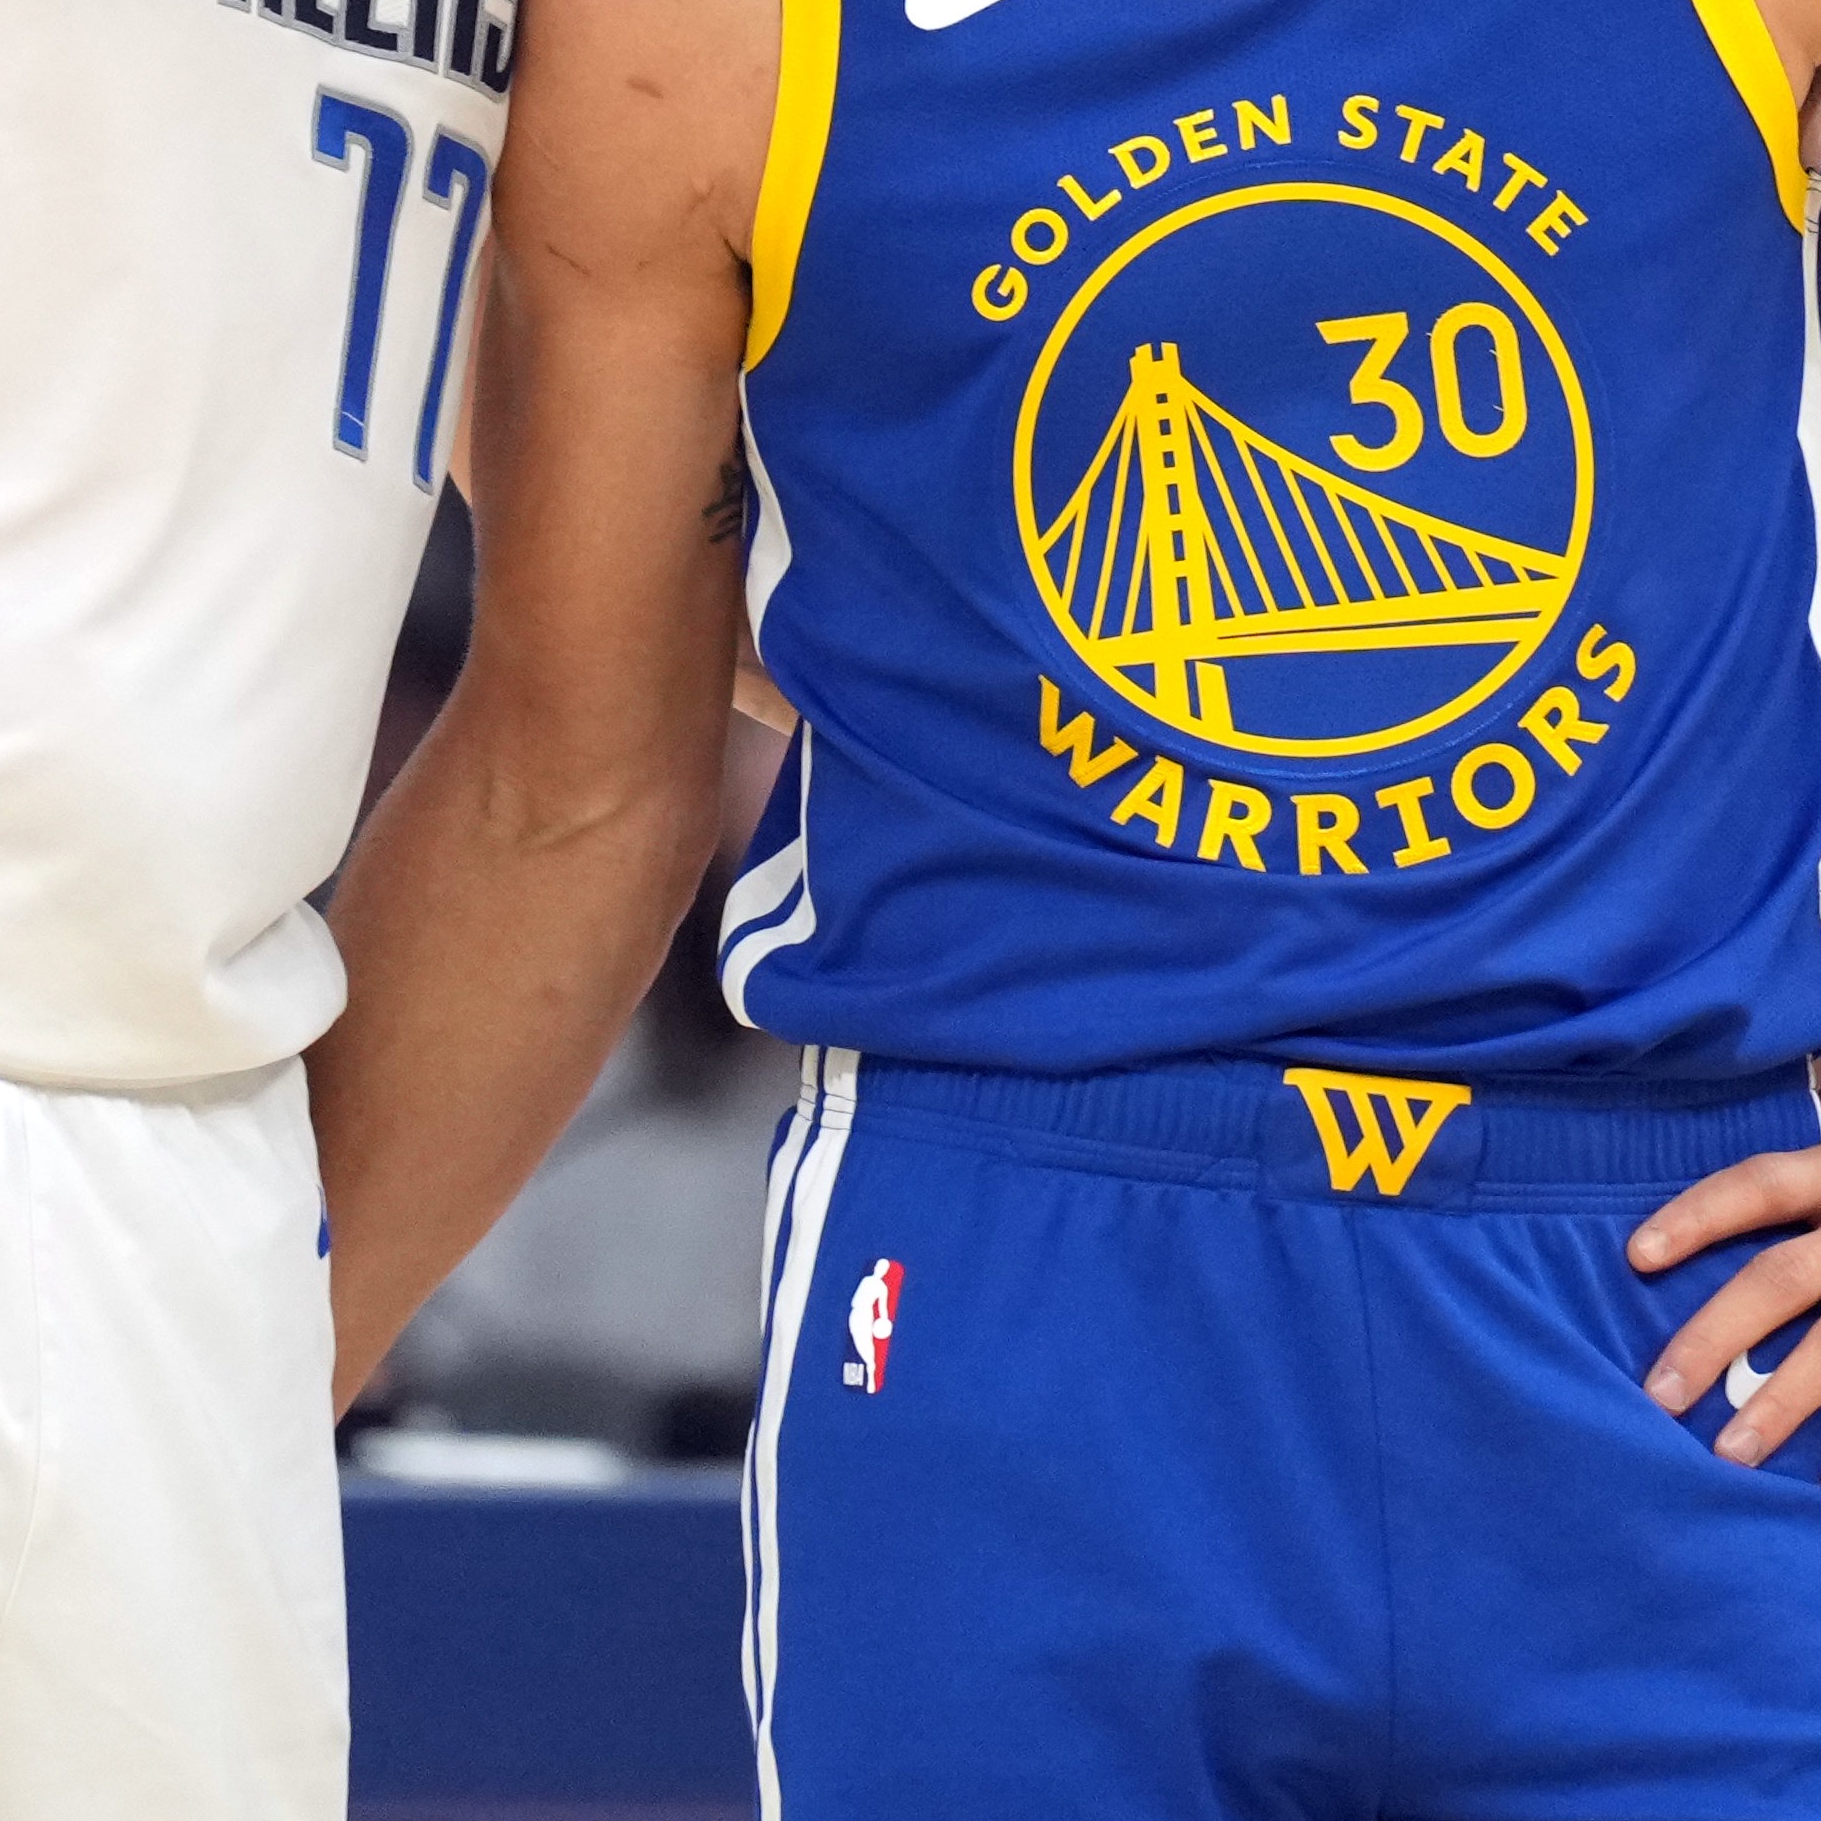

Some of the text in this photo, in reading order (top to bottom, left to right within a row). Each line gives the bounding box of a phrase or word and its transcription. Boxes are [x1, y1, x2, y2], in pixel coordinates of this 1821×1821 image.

[310, 84, 492, 495] 77
[971, 94, 1589, 322] GOLDEN STATE
[1316, 302, 1528, 473] 30
[1037, 623, 1637, 875] WARRIORS
